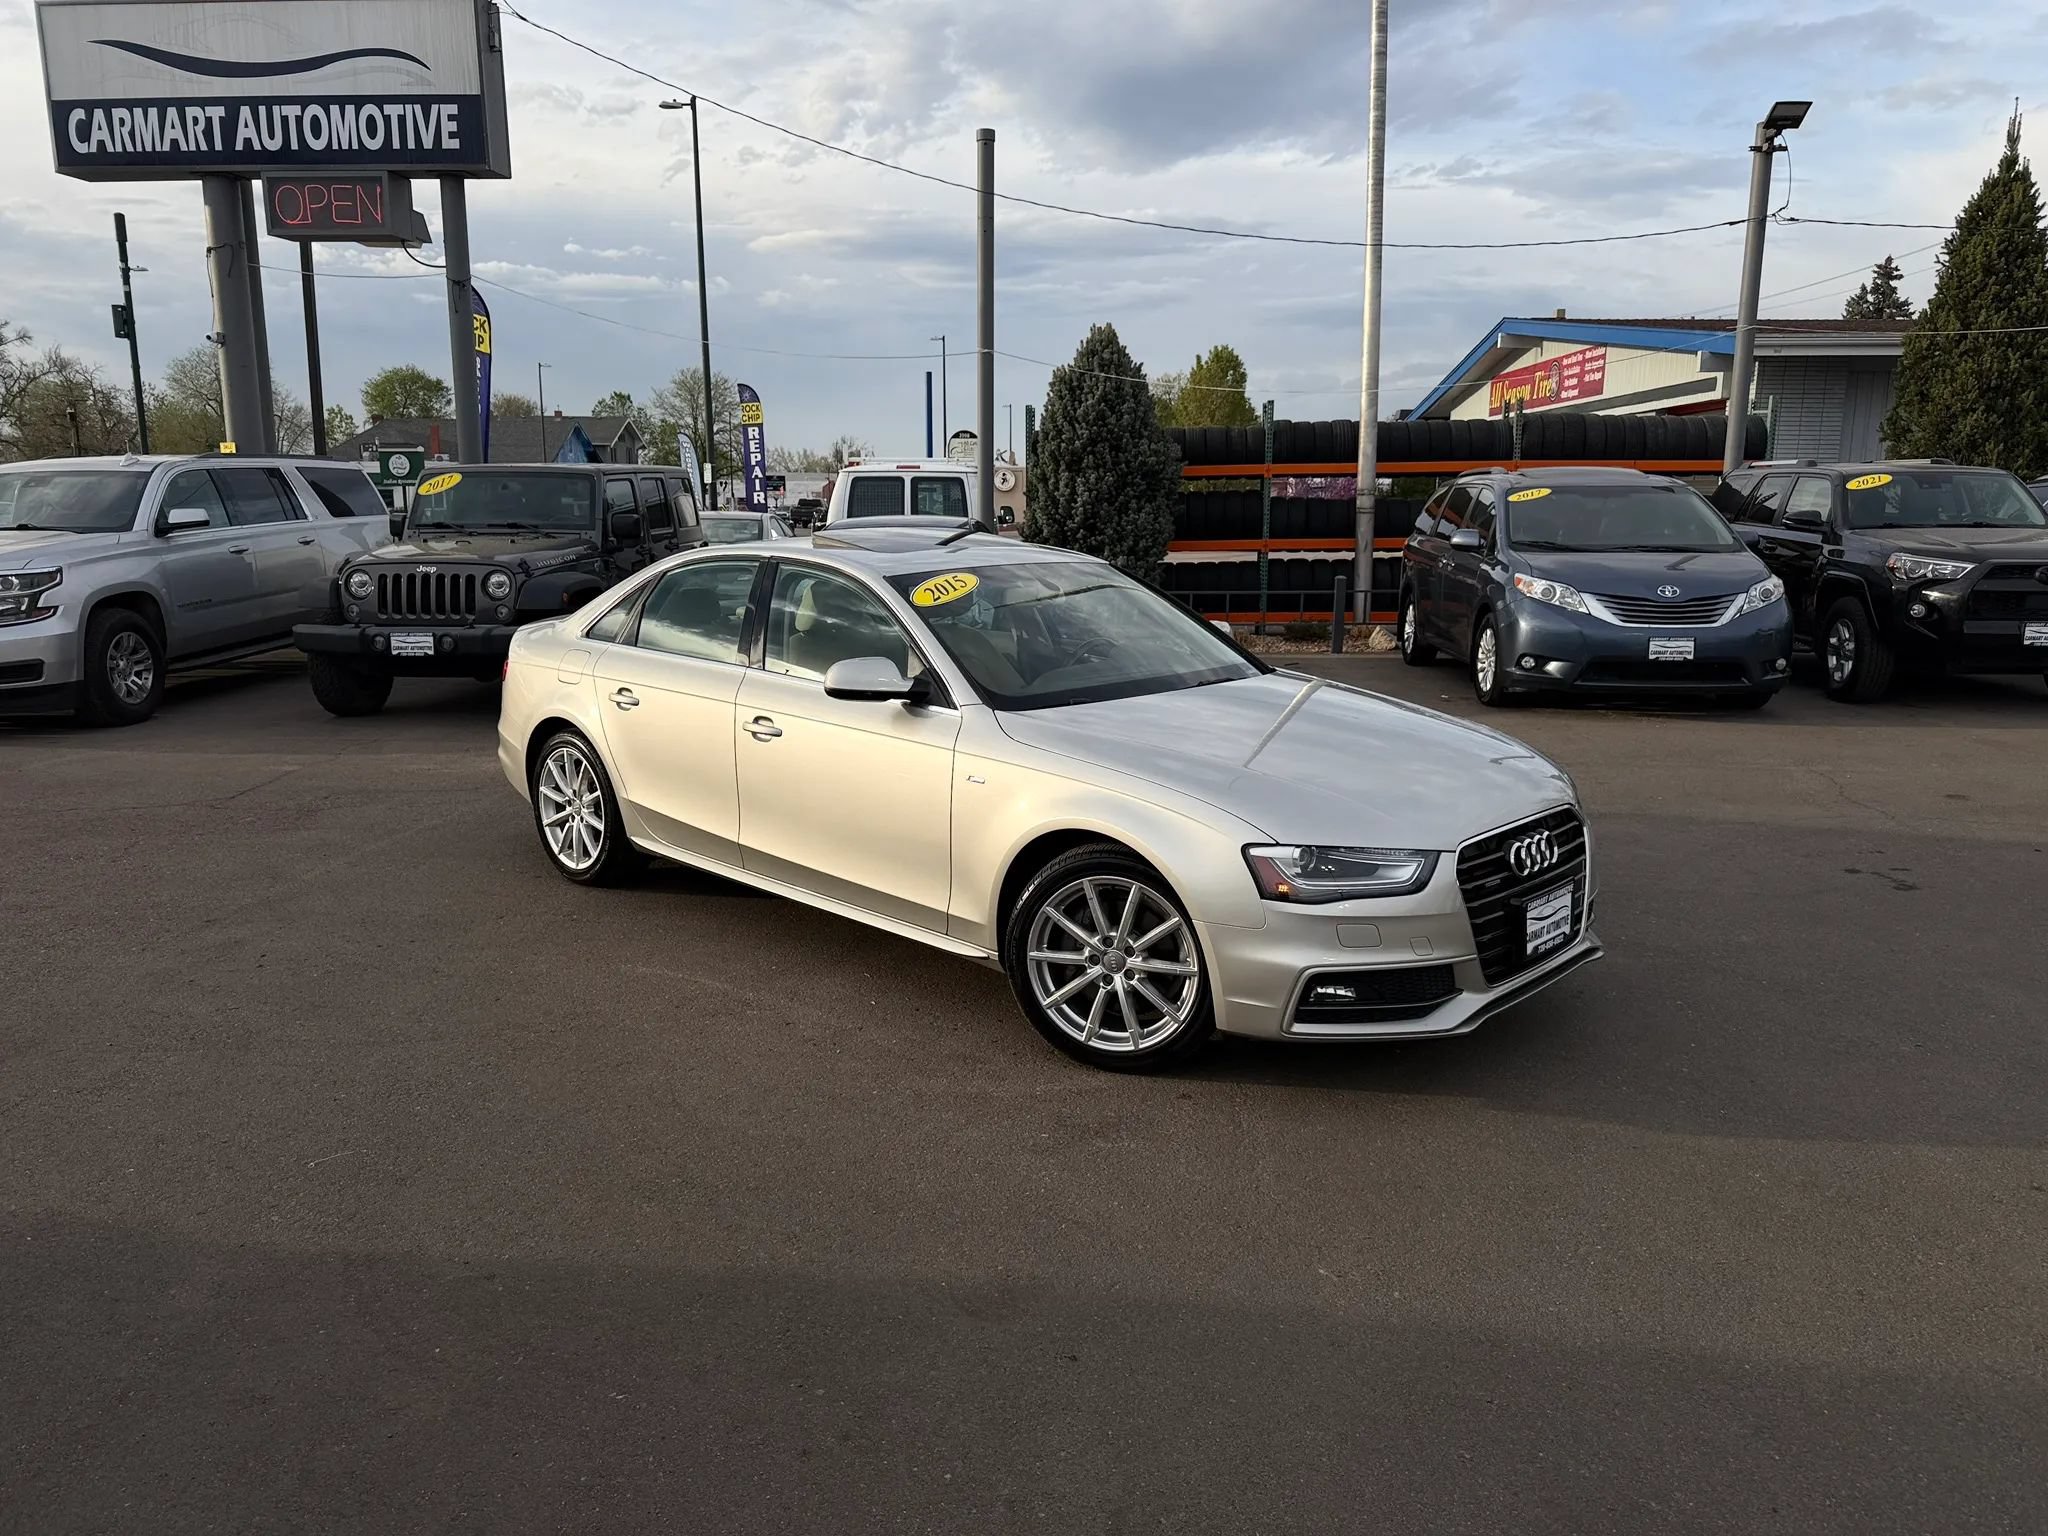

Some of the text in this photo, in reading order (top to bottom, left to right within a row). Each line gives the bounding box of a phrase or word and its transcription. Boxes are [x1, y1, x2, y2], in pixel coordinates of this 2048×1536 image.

[67, 103, 460, 154] CARMART AUTOMOTIVE
[274, 184, 383, 225] OPEN
[1490, 370, 1552, 409] All Season Tire
[741, 403, 761, 413] ROCK
[741, 413, 761, 423] CHIP
[748, 427, 766, 504] REPAIR
[425, 475, 454, 493] 2017
[1855, 475, 1882, 488] 2021
[1516, 490, 1541, 500] 2017
[416, 565, 437, 573] Jeep
[923, 575, 968, 602] 2015
